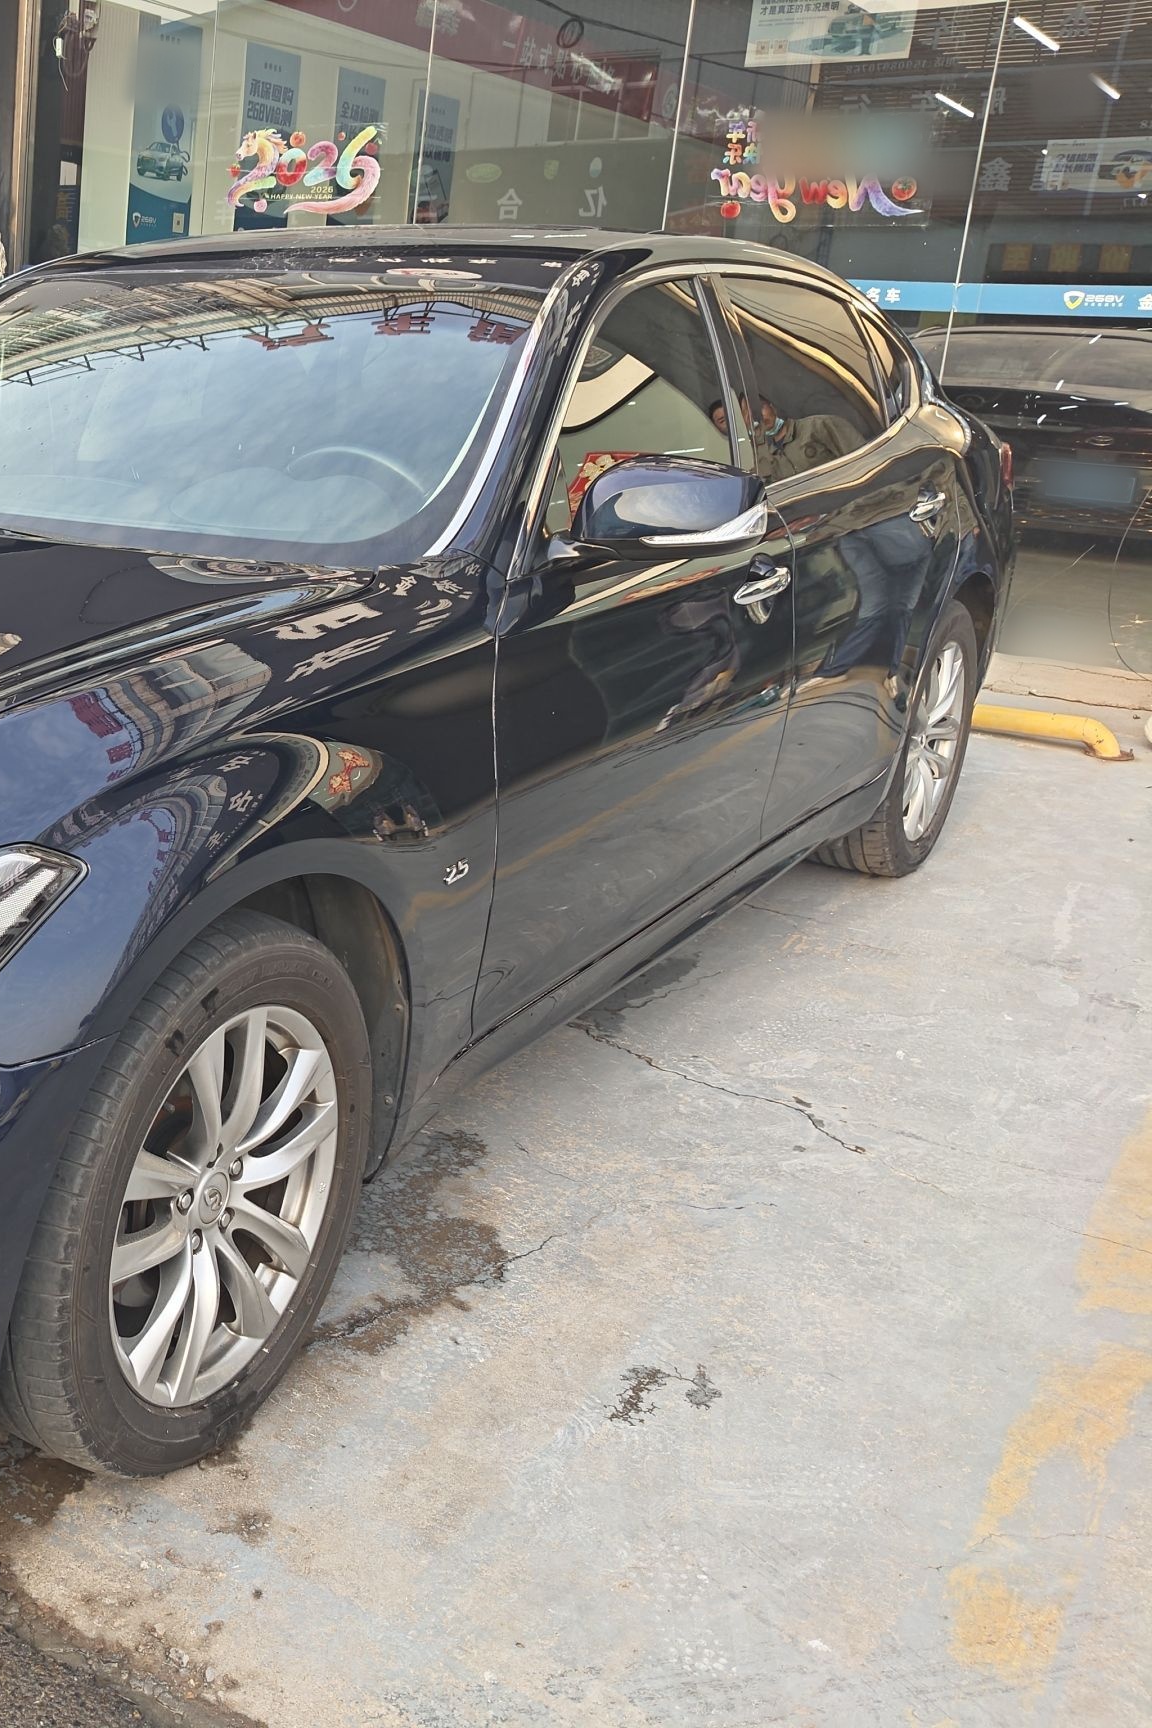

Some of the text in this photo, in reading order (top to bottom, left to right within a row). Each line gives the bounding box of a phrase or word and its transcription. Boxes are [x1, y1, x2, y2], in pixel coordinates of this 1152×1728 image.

[249, 78, 295, 106] 承保回购
[246, 100, 294, 128] 268V检测
[310, 186, 334, 194] 2026
[1085, 294, 1126, 304] 268V
